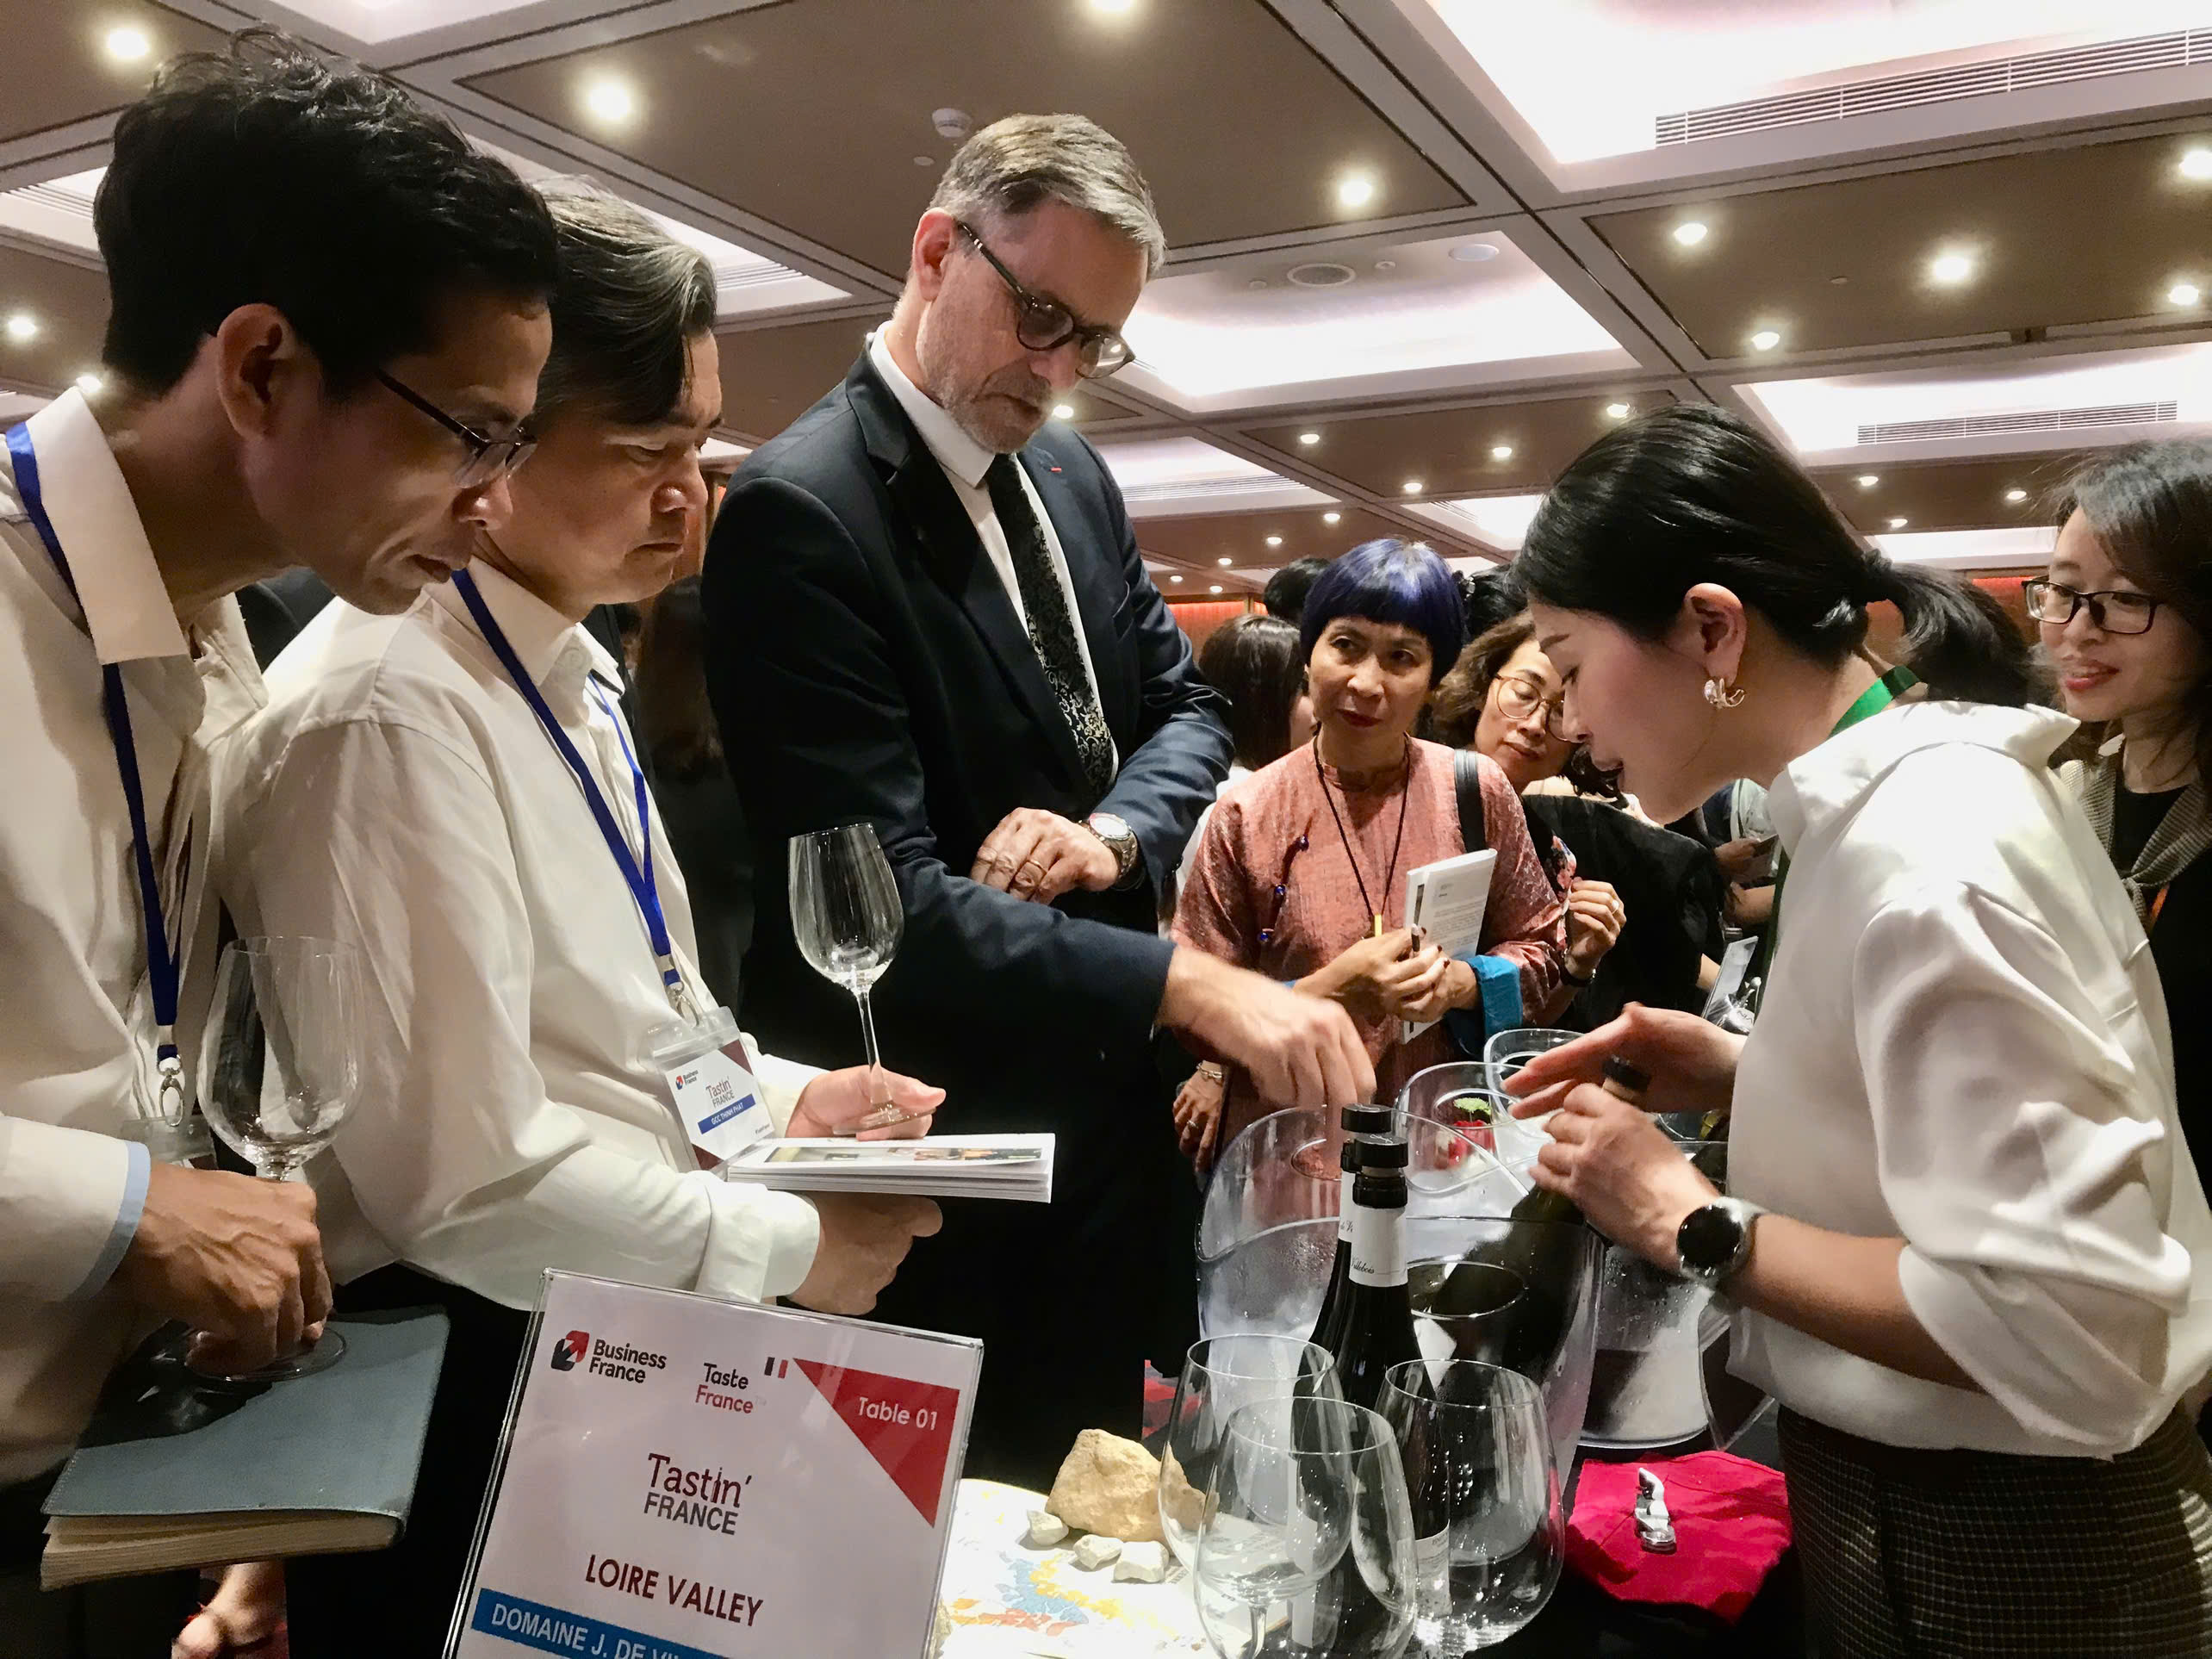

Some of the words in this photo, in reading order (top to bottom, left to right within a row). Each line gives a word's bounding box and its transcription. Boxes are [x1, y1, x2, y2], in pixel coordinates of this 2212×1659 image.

[712, 1090, 735, 1108] FRANCE
[589, 1357, 646, 1383] France
[593, 1339, 667, 1370] Business
[704, 1363, 749, 1389] Taste
[695, 1384, 754, 1414] France
[859, 1396, 910, 1425] Table
[916, 1408, 938, 1431] 01
[648, 1453, 752, 1508] Tastin'
[643, 1491, 738, 1535] FRANCE
[585, 1554, 659, 1599] LOIRE
[668, 1575, 763, 1627] VALLEY
[491, 1603, 588, 1650] DOMAINE
[591, 1633, 607, 1658] J.
[614, 1639, 646, 1659] DE
